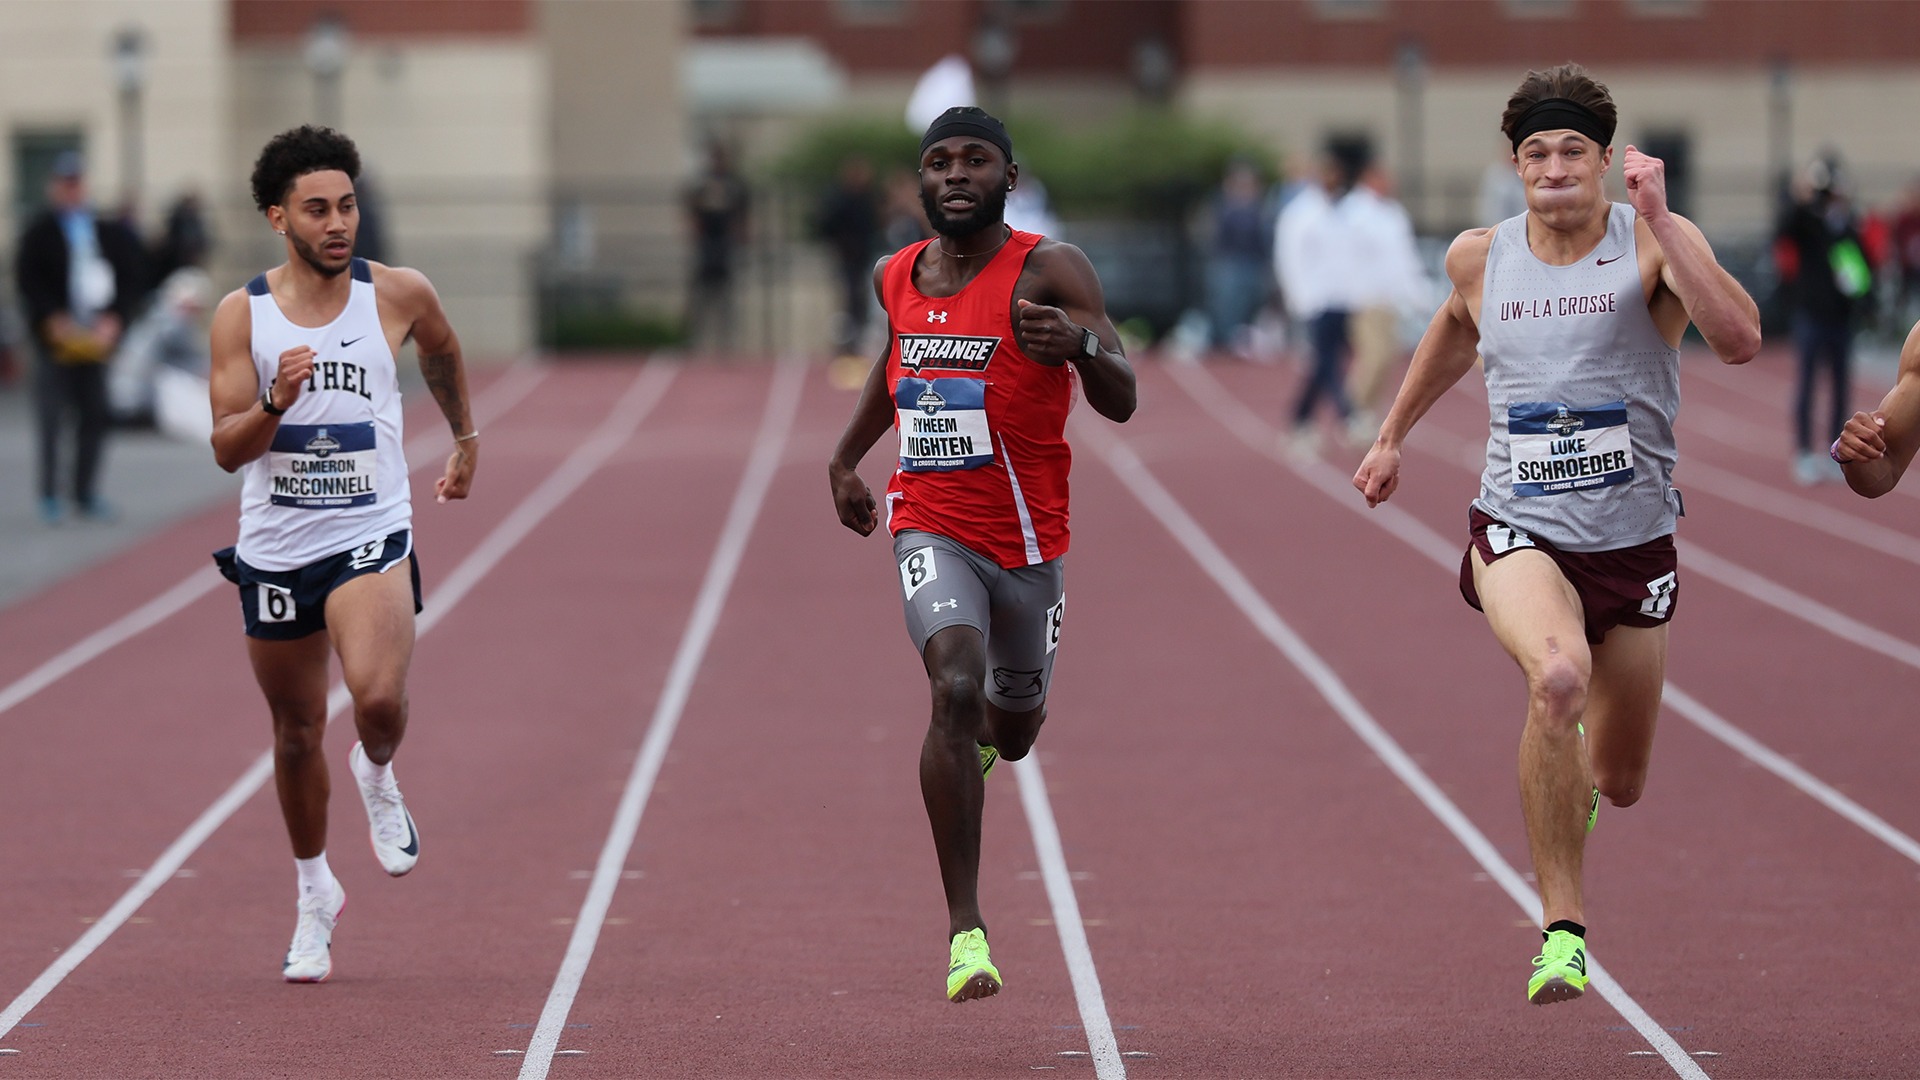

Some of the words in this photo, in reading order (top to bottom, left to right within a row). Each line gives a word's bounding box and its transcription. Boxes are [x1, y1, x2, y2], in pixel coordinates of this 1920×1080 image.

[1500, 299, 1552, 321] UW-LA
[1558, 292, 1616, 316] CROSSE
[921, 359, 983, 369] COLLEGE
[271, 361, 372, 401] THEL
[913, 417, 958, 433] RYHEEM
[907, 435, 974, 457] MIGHTEN
[1550, 438, 1587, 456] LUKE
[291, 459, 356, 474] CAMERON
[1517, 450, 1627, 482] SCHROEDER
[274, 474, 374, 496] MCCONNELL
[907, 552, 928, 588] 8
[267, 587, 287, 620] 6
[1051, 601, 1063, 644] 8
